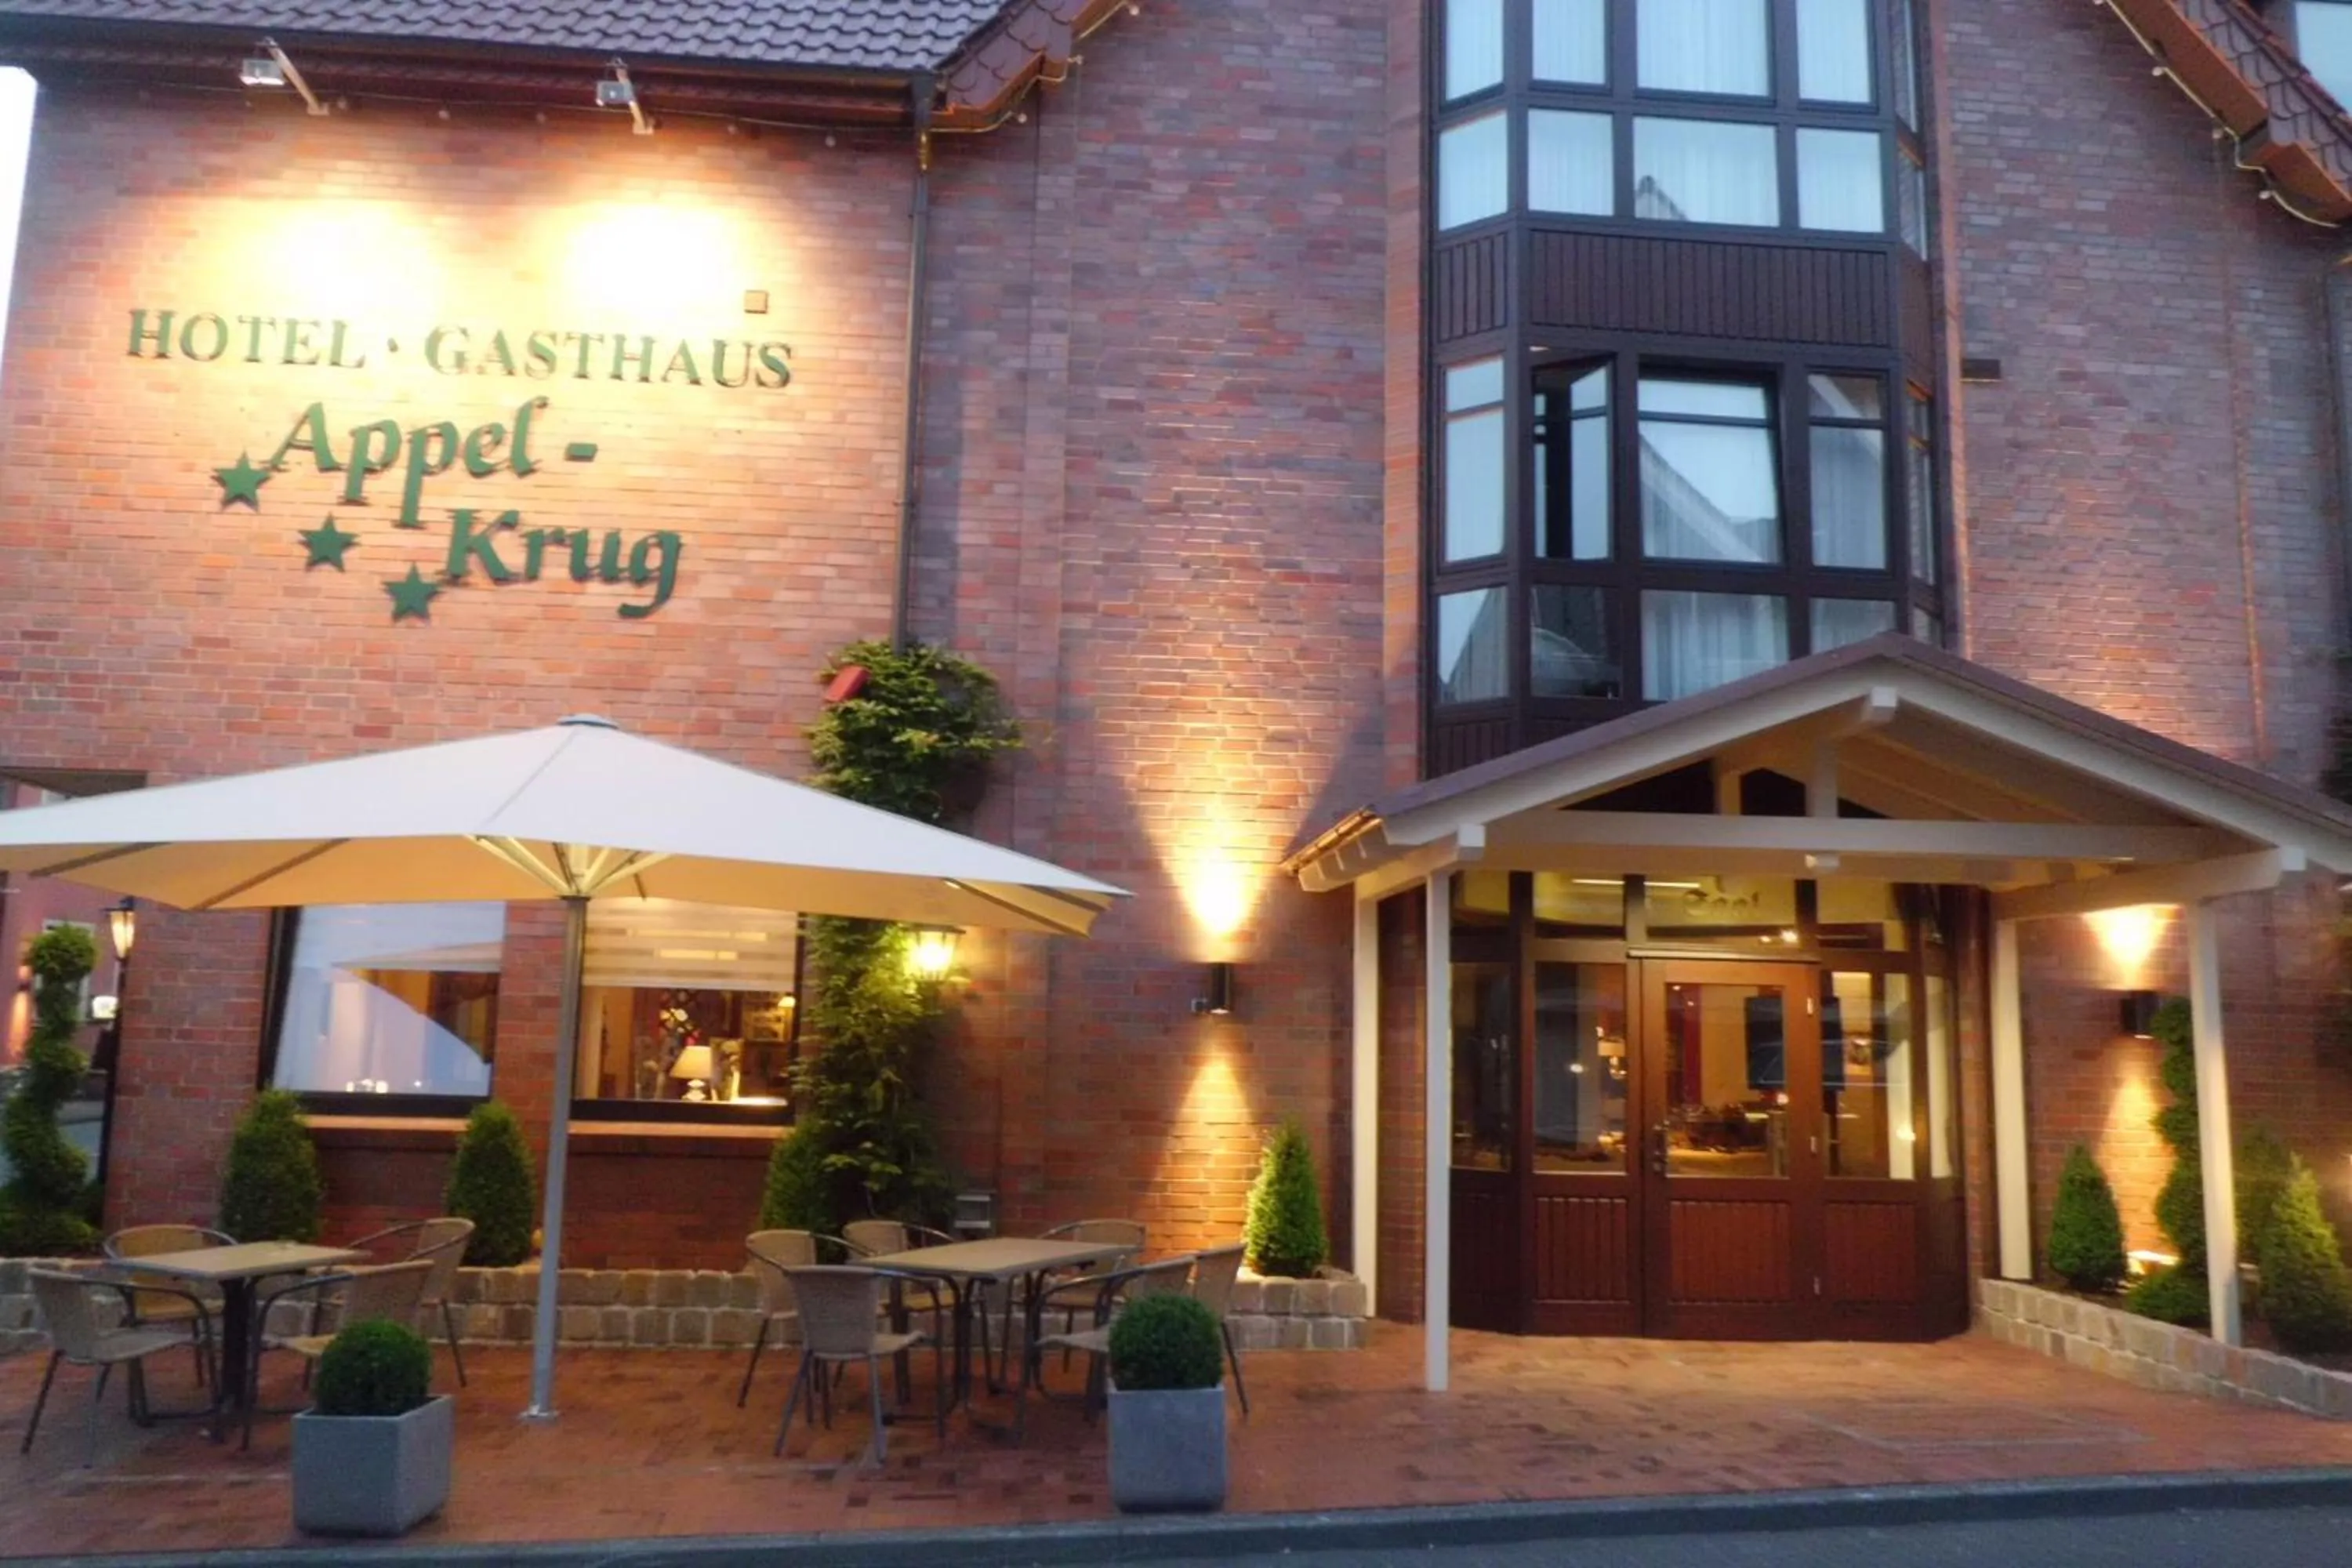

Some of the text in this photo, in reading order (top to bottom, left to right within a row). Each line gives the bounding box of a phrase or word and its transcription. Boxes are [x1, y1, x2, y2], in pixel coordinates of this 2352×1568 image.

[127, 309, 366, 368] HOTEL
[424, 324, 793, 389] GASTHAUS
[436, 508, 683, 619] Krug
